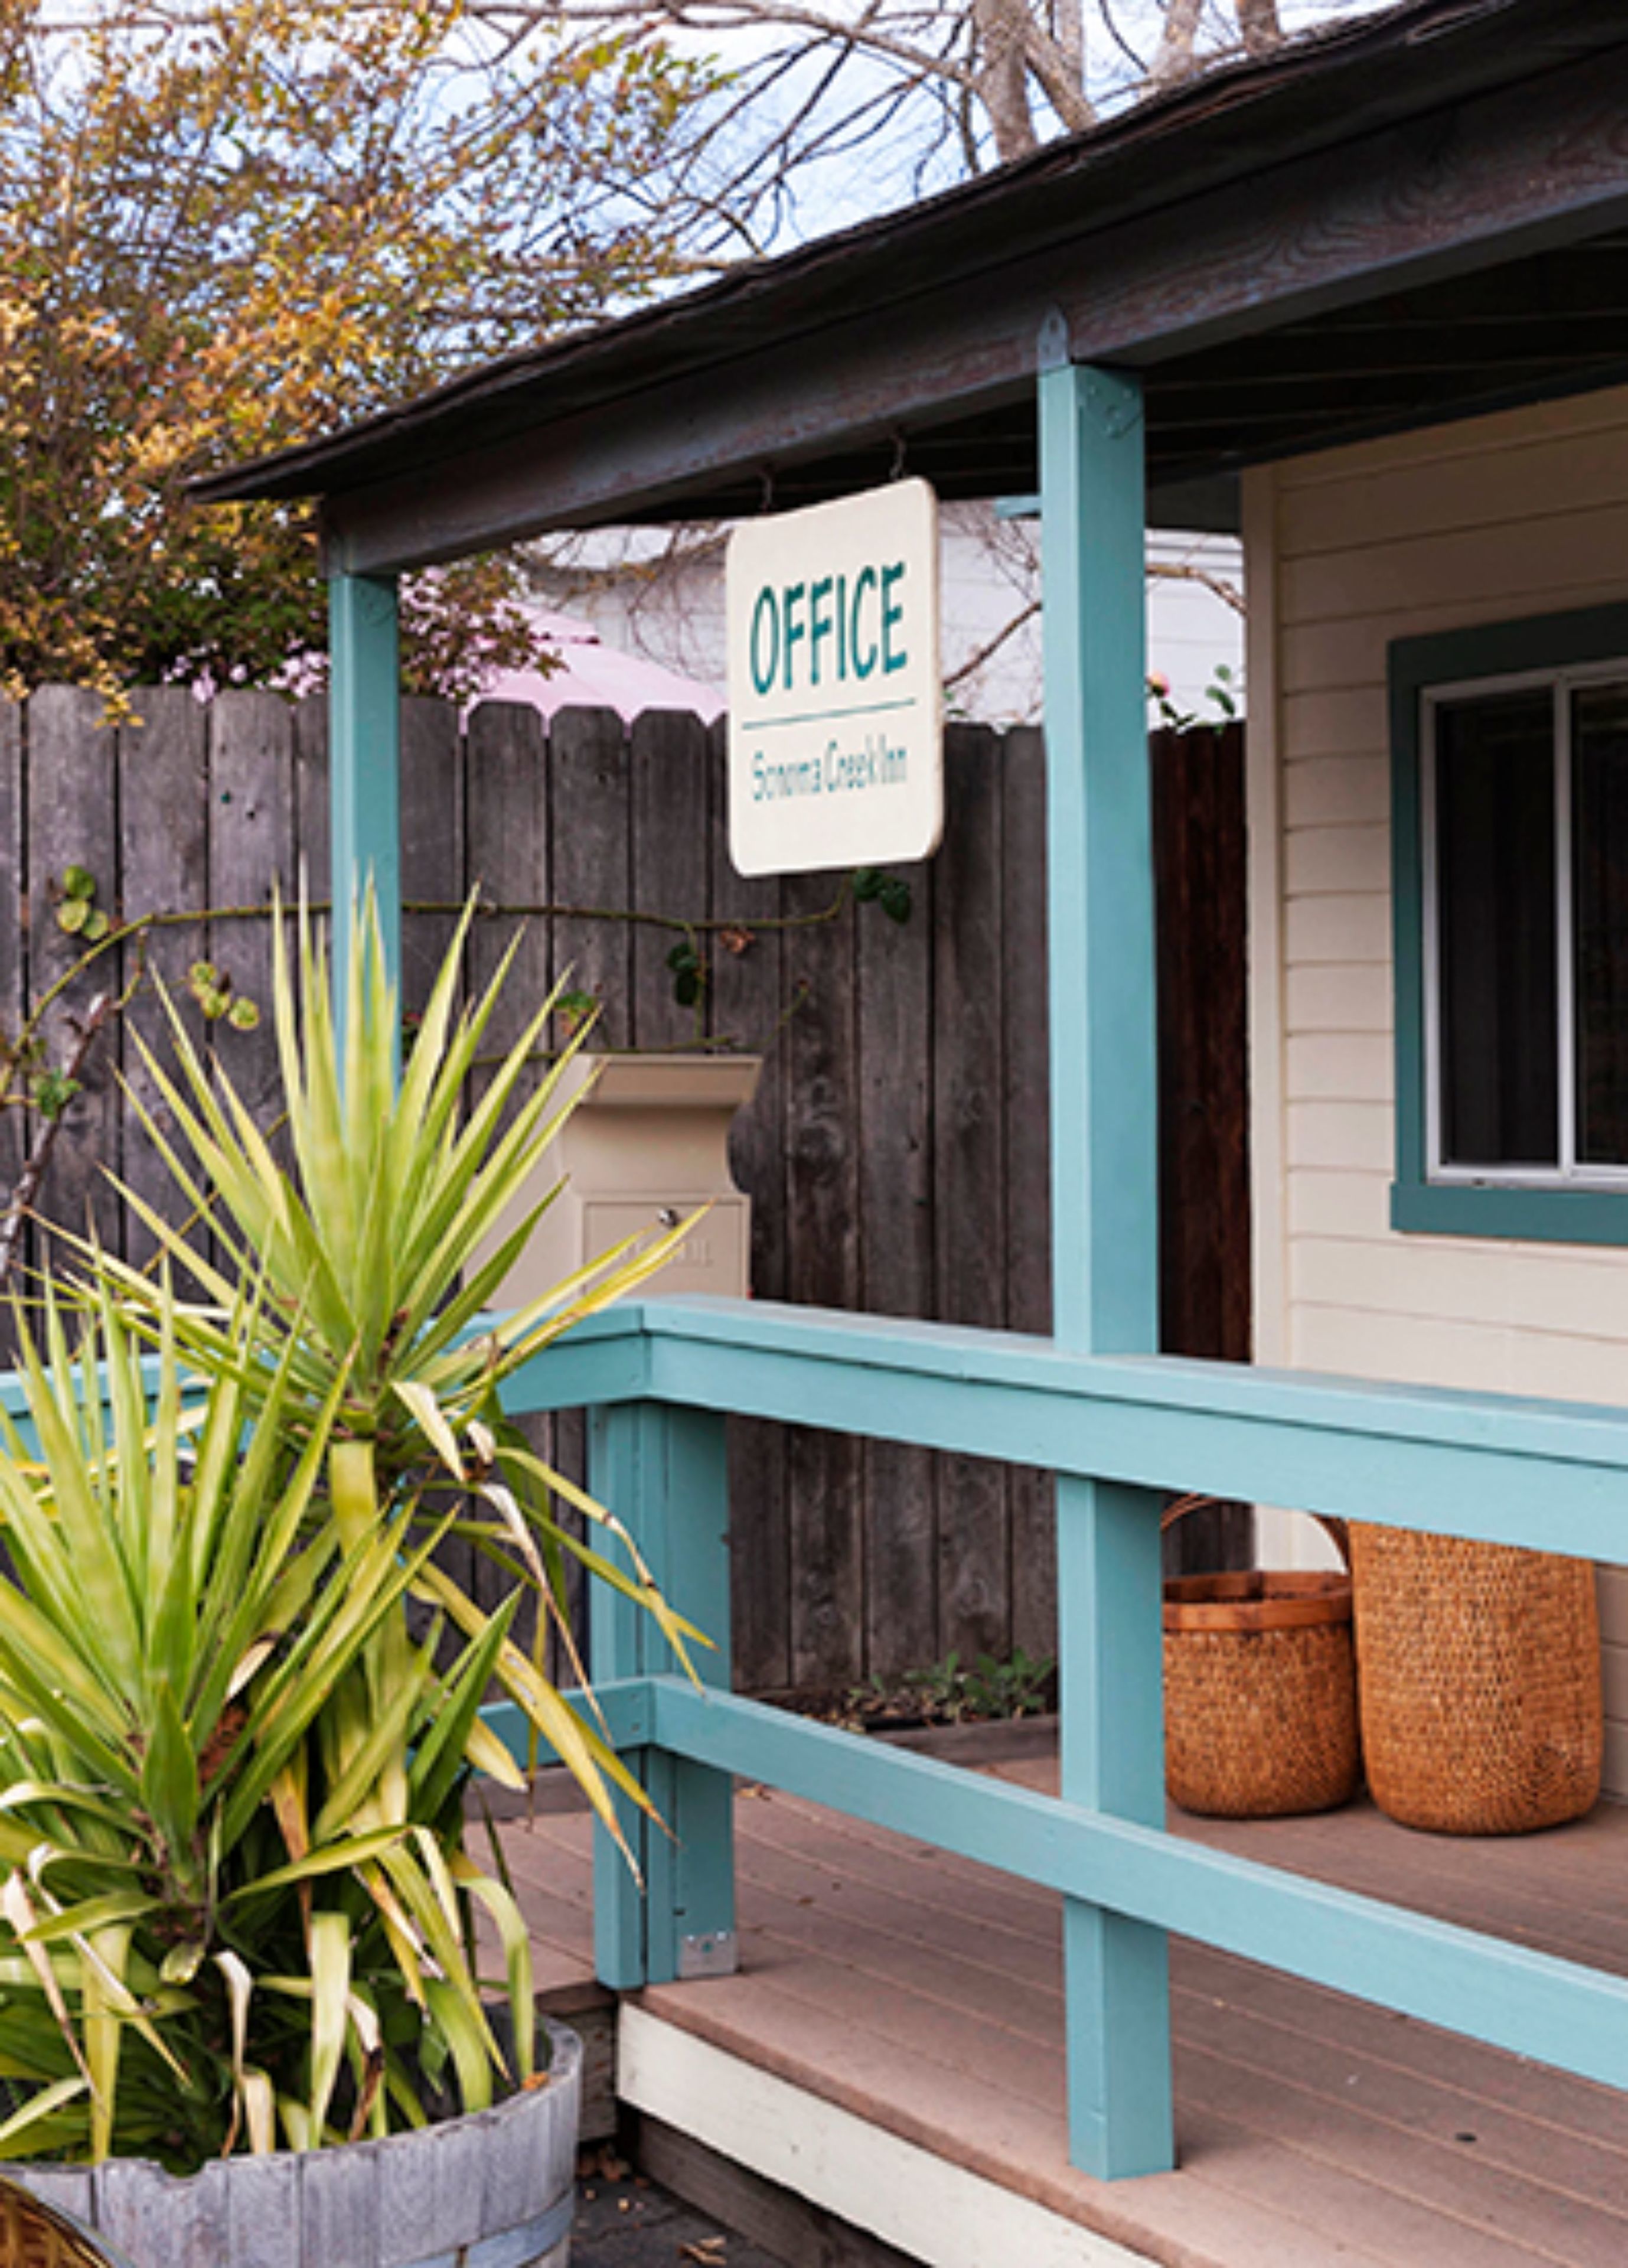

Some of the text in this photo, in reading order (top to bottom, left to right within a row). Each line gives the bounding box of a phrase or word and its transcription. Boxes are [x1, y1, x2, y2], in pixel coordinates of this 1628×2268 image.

[750, 561, 908, 695] OFFICE
[753, 733, 907, 801] Sonoma Creek Inn
